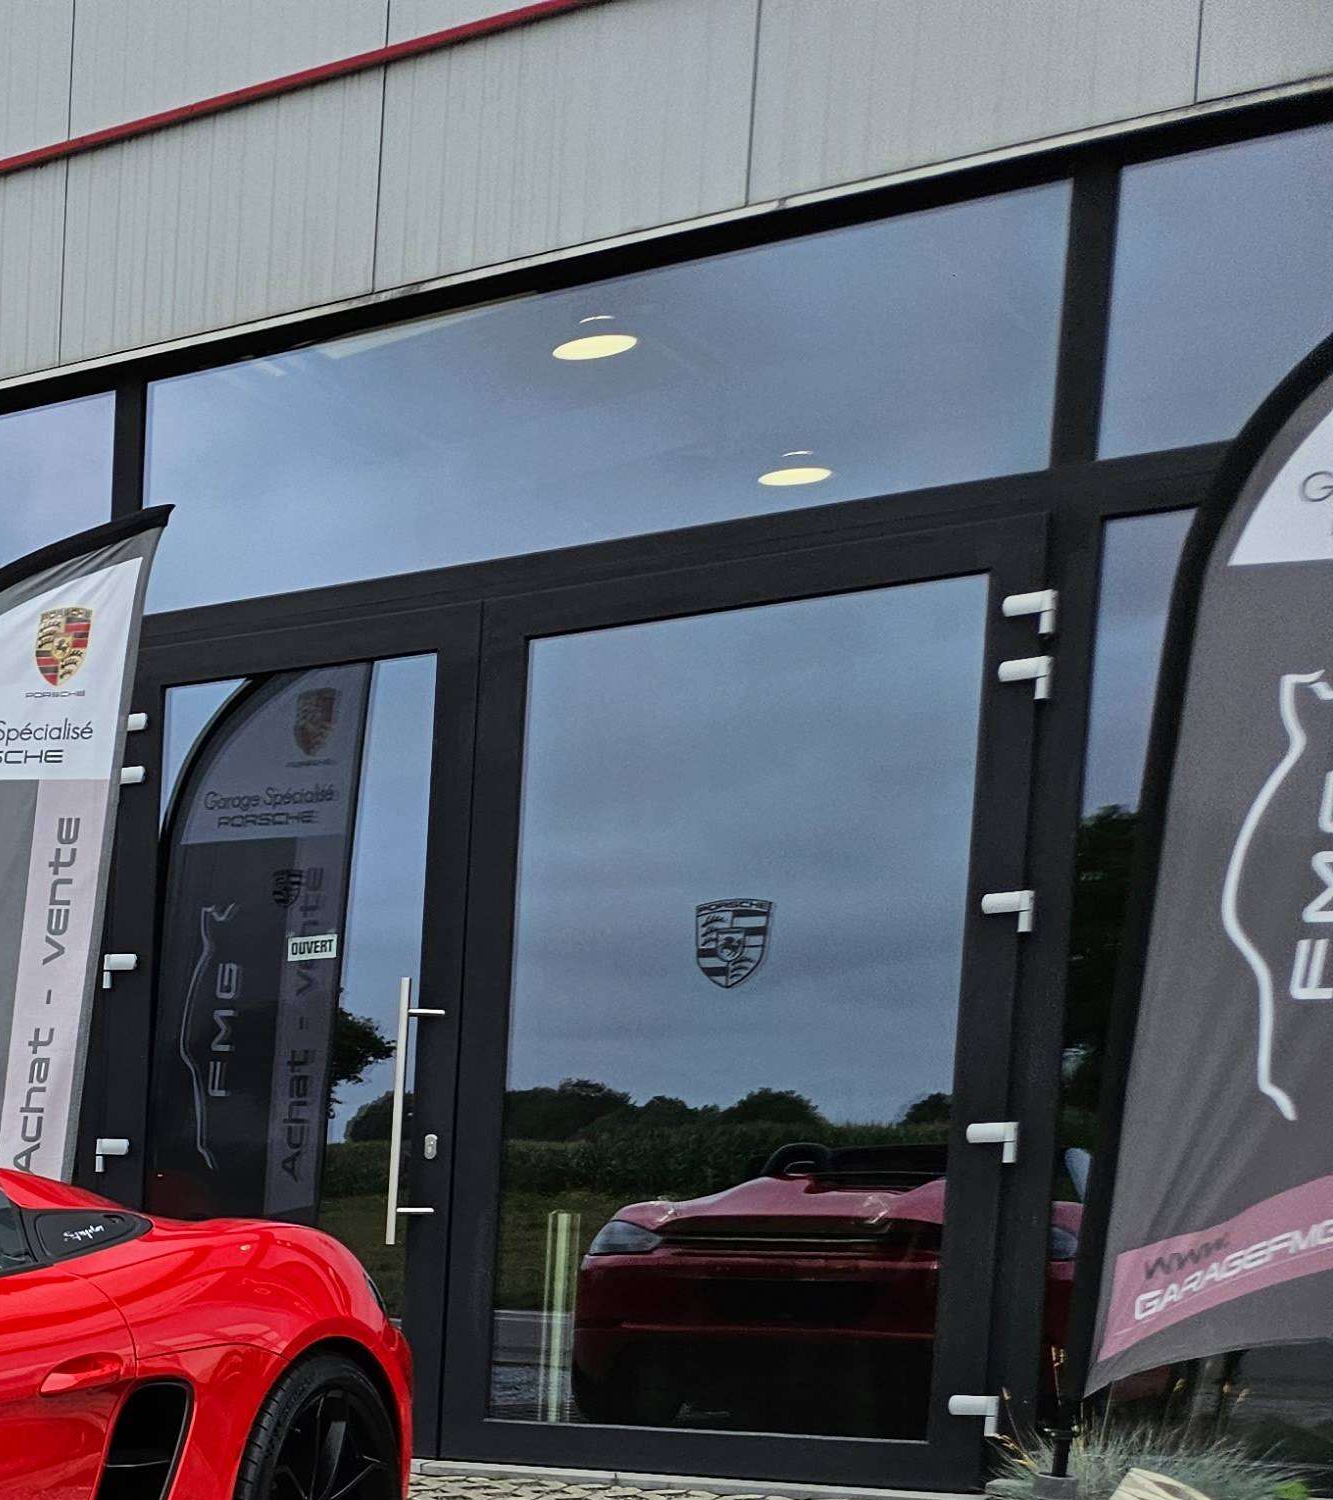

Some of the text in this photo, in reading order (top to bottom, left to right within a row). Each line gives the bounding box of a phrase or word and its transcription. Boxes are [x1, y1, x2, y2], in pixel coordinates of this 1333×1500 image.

[204, 791, 260, 811] Garage
[217, 810, 318, 828] PORSCHE
[292, 939, 334, 955] OUVERT
[209, 963, 239, 1097] FMG
[14, 1028, 54, 1171] Achat
[282, 1048, 313, 1183] Achat
